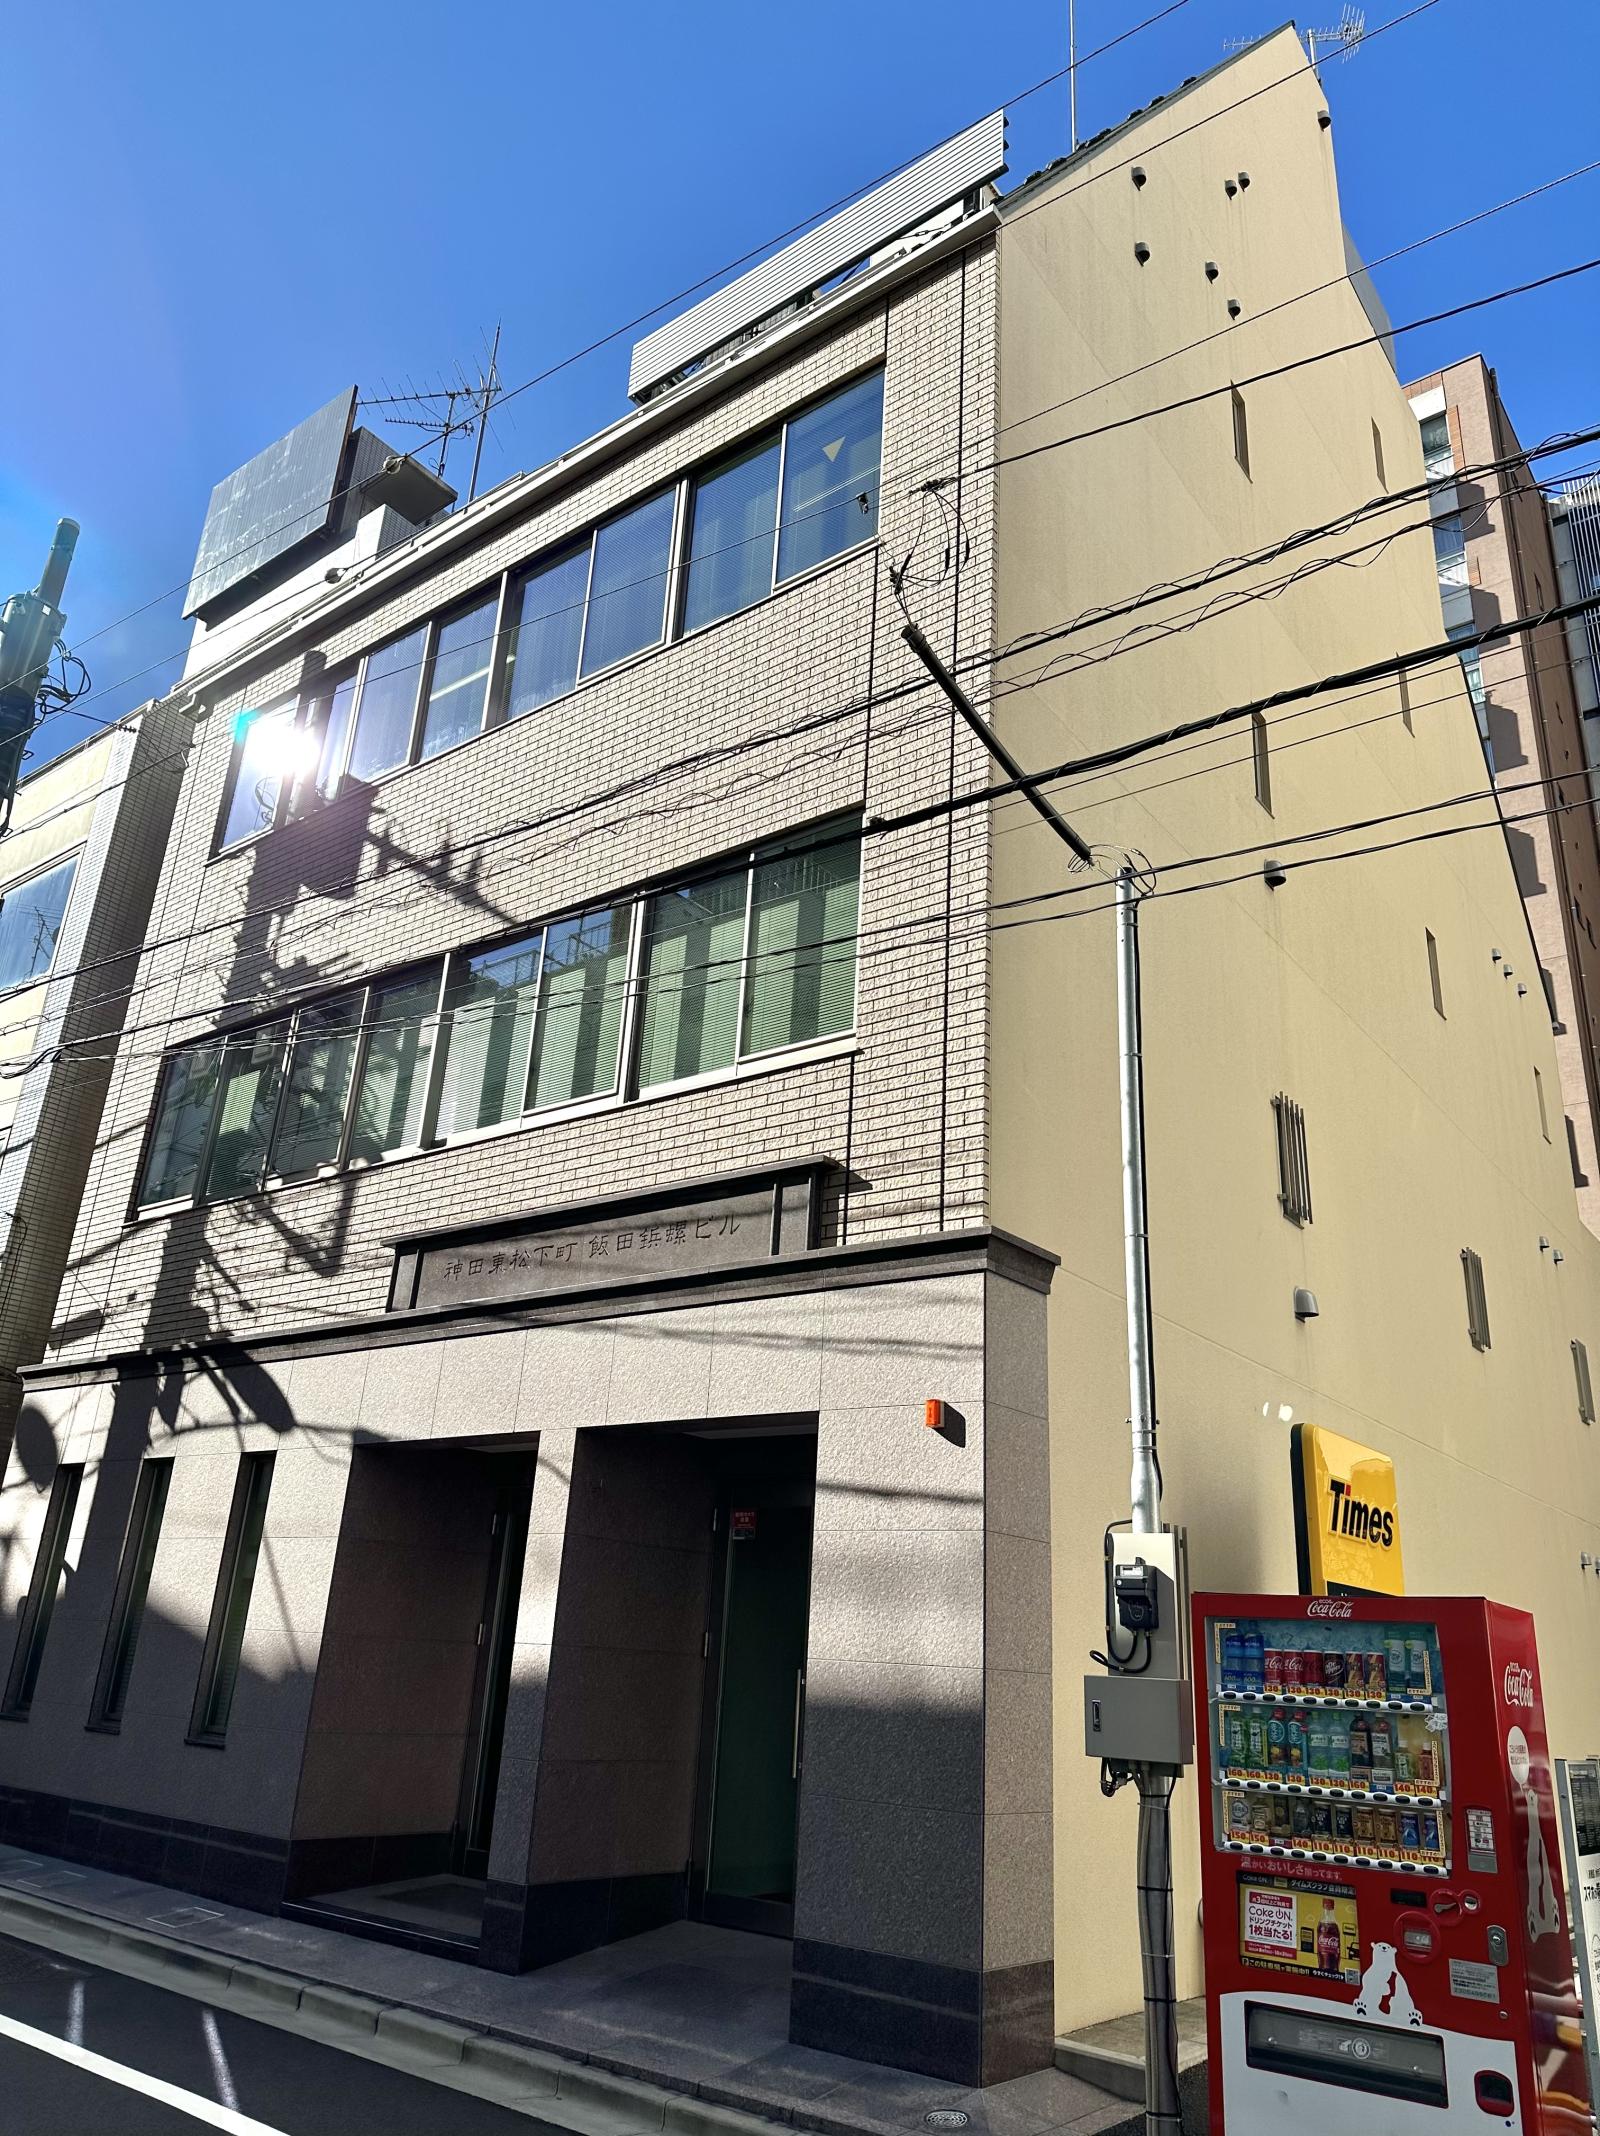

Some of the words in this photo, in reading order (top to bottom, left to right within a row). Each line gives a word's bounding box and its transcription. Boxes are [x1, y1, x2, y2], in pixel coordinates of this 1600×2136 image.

[443, 1242, 578, 1281] 神田東松下町
[1329, 1478, 1394, 1547] Times
[1248, 1905, 1274, 1918] Coke
[1249, 1916, 1293, 1930] ドリンクチケット
